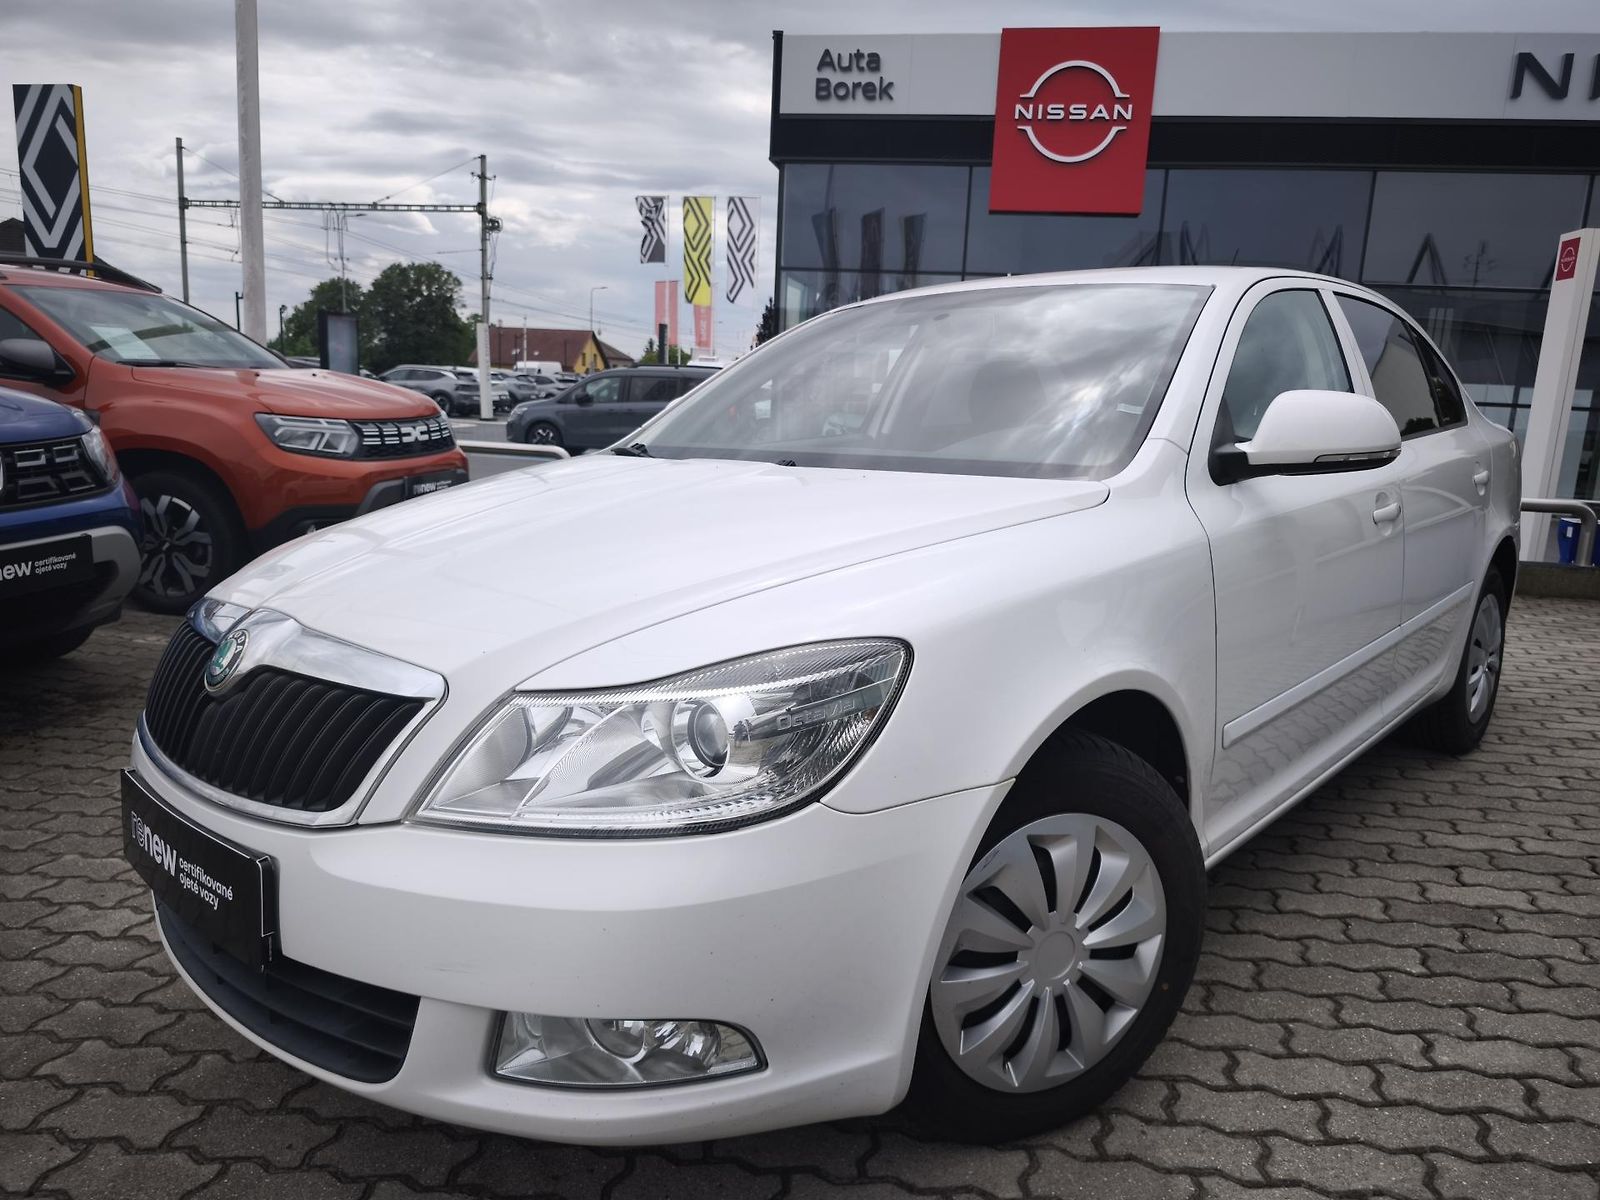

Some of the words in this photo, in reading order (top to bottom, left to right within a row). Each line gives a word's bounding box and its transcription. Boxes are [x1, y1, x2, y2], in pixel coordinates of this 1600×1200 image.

[816, 48, 881, 73] Auta
[815, 76, 895, 102] Borek
[1014, 103, 1133, 121] NISSAN
[0, 561, 32, 581] ew
[131, 811, 177, 877] renew
[179, 857, 233, 901] certifikované
[180, 872, 199, 895] ojeté
[199, 886, 219, 911] vozy
